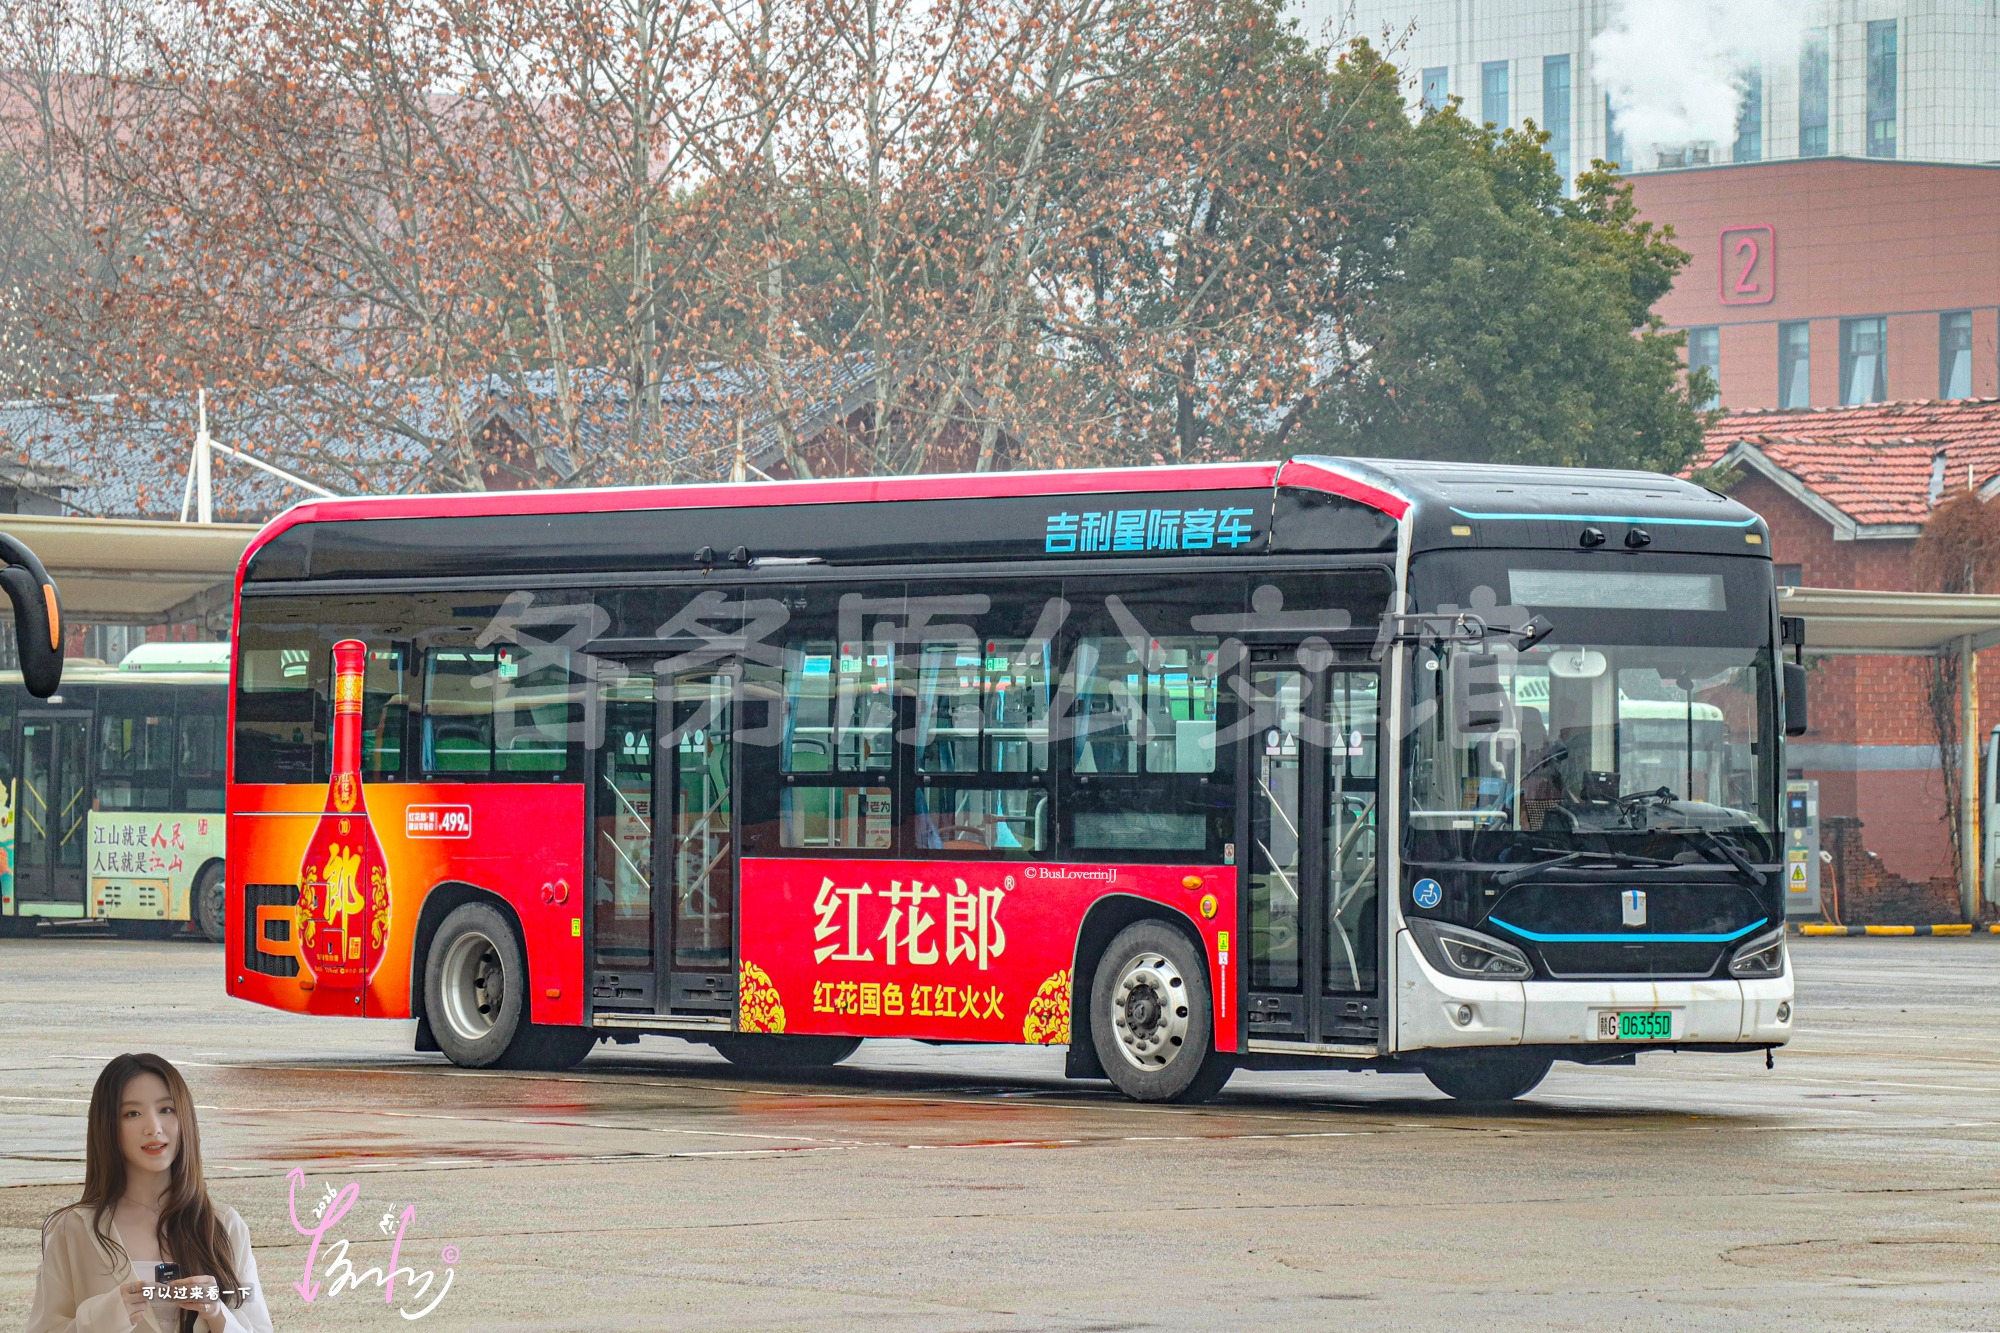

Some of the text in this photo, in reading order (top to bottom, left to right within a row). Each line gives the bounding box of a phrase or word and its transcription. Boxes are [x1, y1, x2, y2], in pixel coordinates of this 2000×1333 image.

[1734, 236, 1760, 293] 2
[1045, 507, 1254, 553] 吉利星际客车
[93, 823, 185, 851] 江山就是人民
[93, 850, 183, 873] 人民就是江山
[813, 876, 1006, 970] 红花郎
[813, 980, 1004, 1020] 红花国色 红红火火
